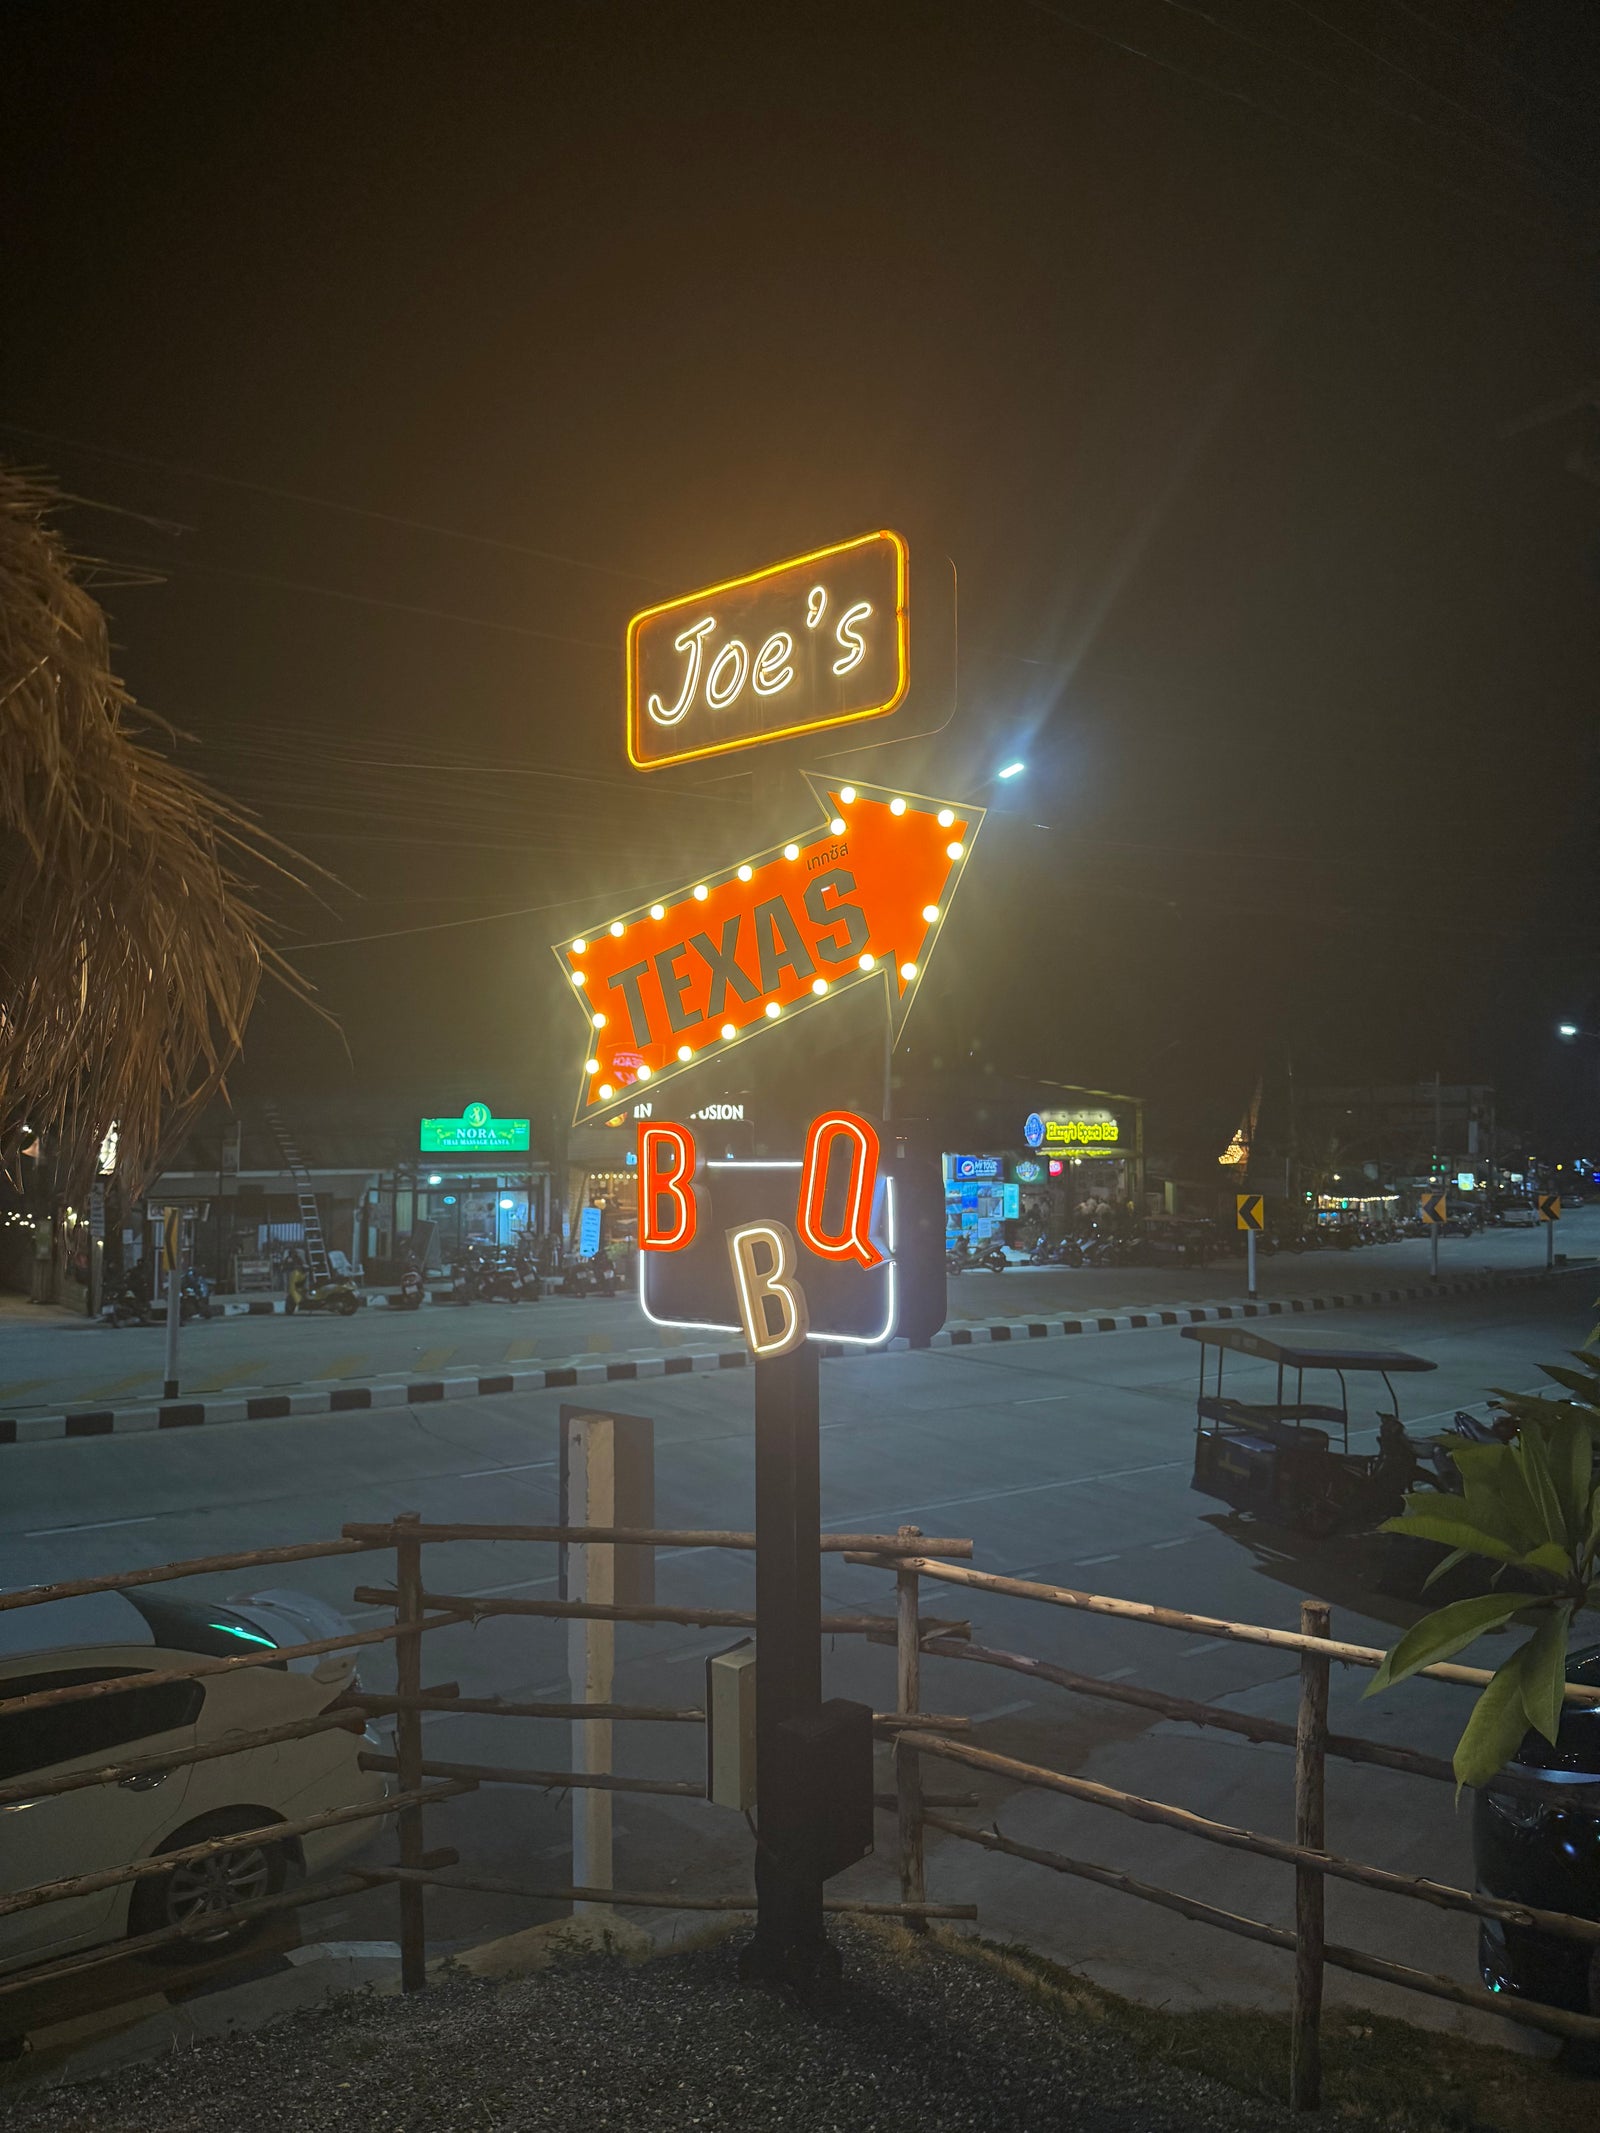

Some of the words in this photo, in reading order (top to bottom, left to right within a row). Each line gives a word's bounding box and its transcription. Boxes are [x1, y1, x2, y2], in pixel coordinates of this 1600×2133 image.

[648, 586, 873, 725] Joe's
[607, 868, 871, 1049] TEXAS
[456, 1128, 497, 1139] NORA
[690, 1105, 744, 1120] USION
